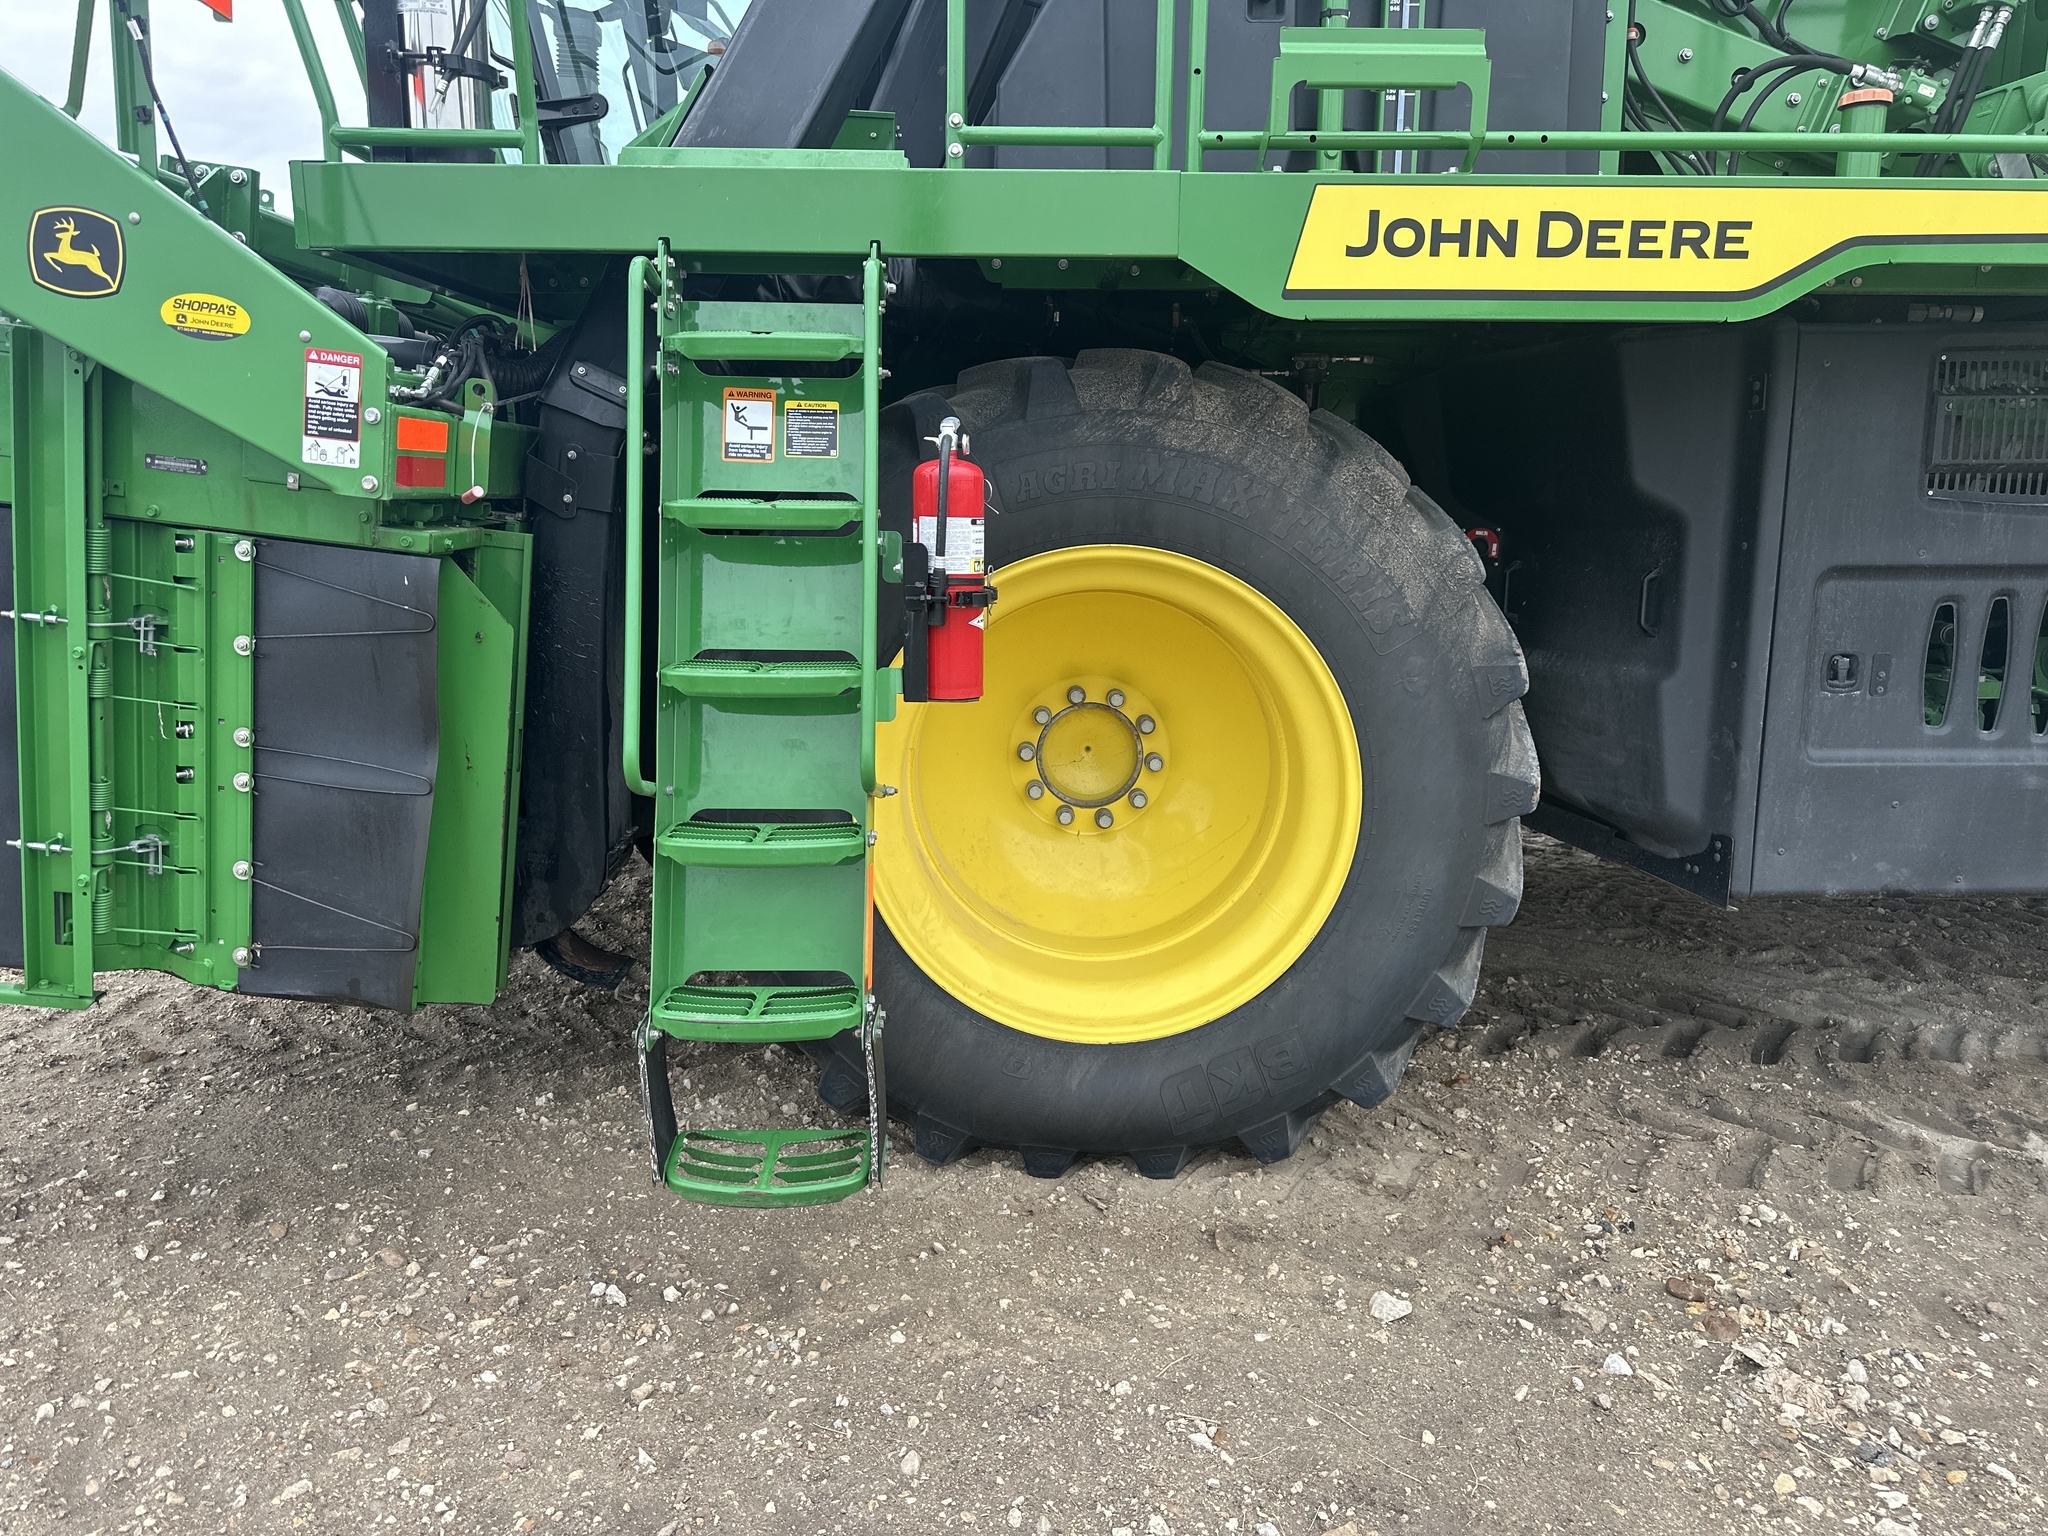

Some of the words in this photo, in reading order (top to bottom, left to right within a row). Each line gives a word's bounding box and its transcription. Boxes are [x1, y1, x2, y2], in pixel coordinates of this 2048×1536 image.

[1345, 209, 1518, 258] JOHN
[1536, 210, 1753, 259] DEERE
[173, 298, 237, 317] SHOPPA'S
[190, 317, 210, 326] JOHN
[210, 319, 234, 329] DEERE
[320, 352, 360, 365] DANGER
[736, 390, 772, 399] WARNING
[1267, 500, 1415, 635] TERIS
[1405, 886, 1434, 939] TUBELESS
[1168, 1032, 1311, 1128] BKT
